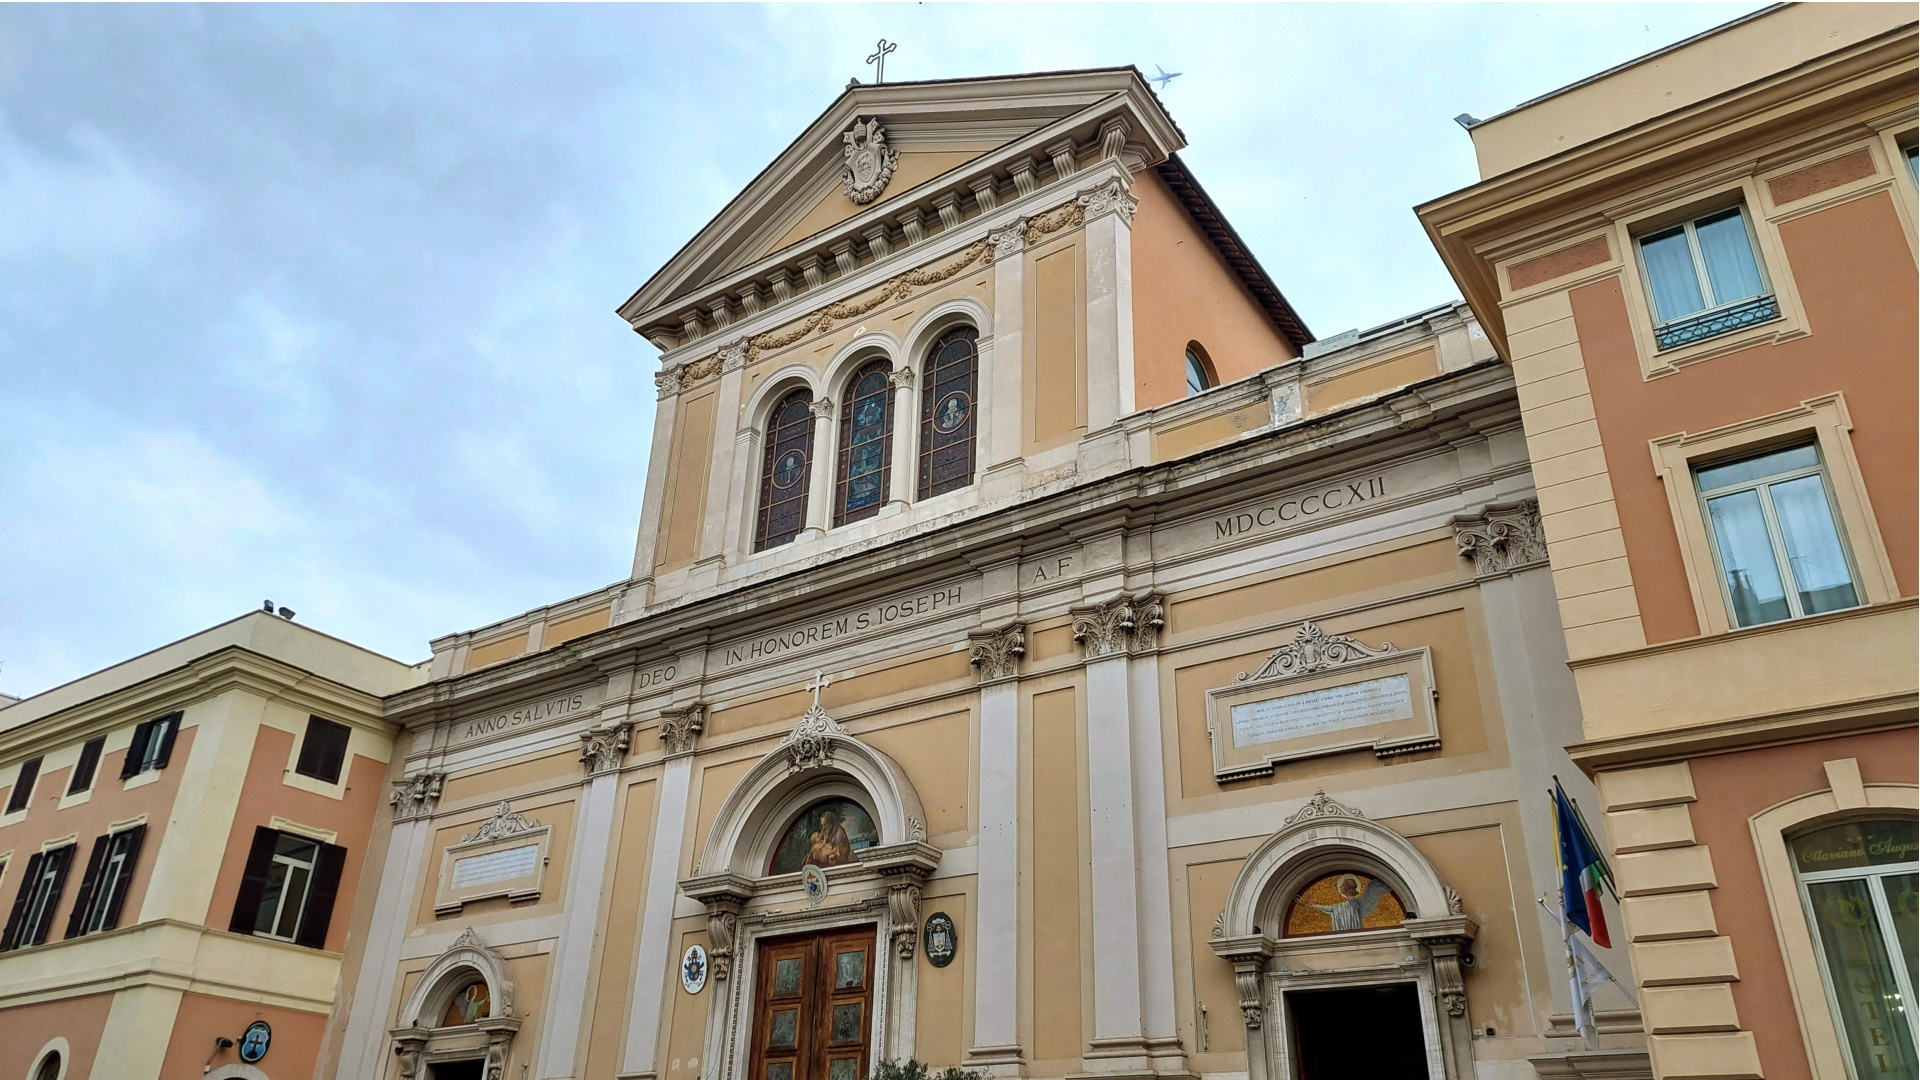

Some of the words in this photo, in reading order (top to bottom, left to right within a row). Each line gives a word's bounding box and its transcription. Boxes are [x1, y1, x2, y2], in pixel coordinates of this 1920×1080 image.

[511, 694, 583, 726] SALVTIS
[638, 666, 676, 689] DEO
[878, 586, 962, 625] IOSEPH
[1214, 476, 1386, 541] MDCCCCXII
